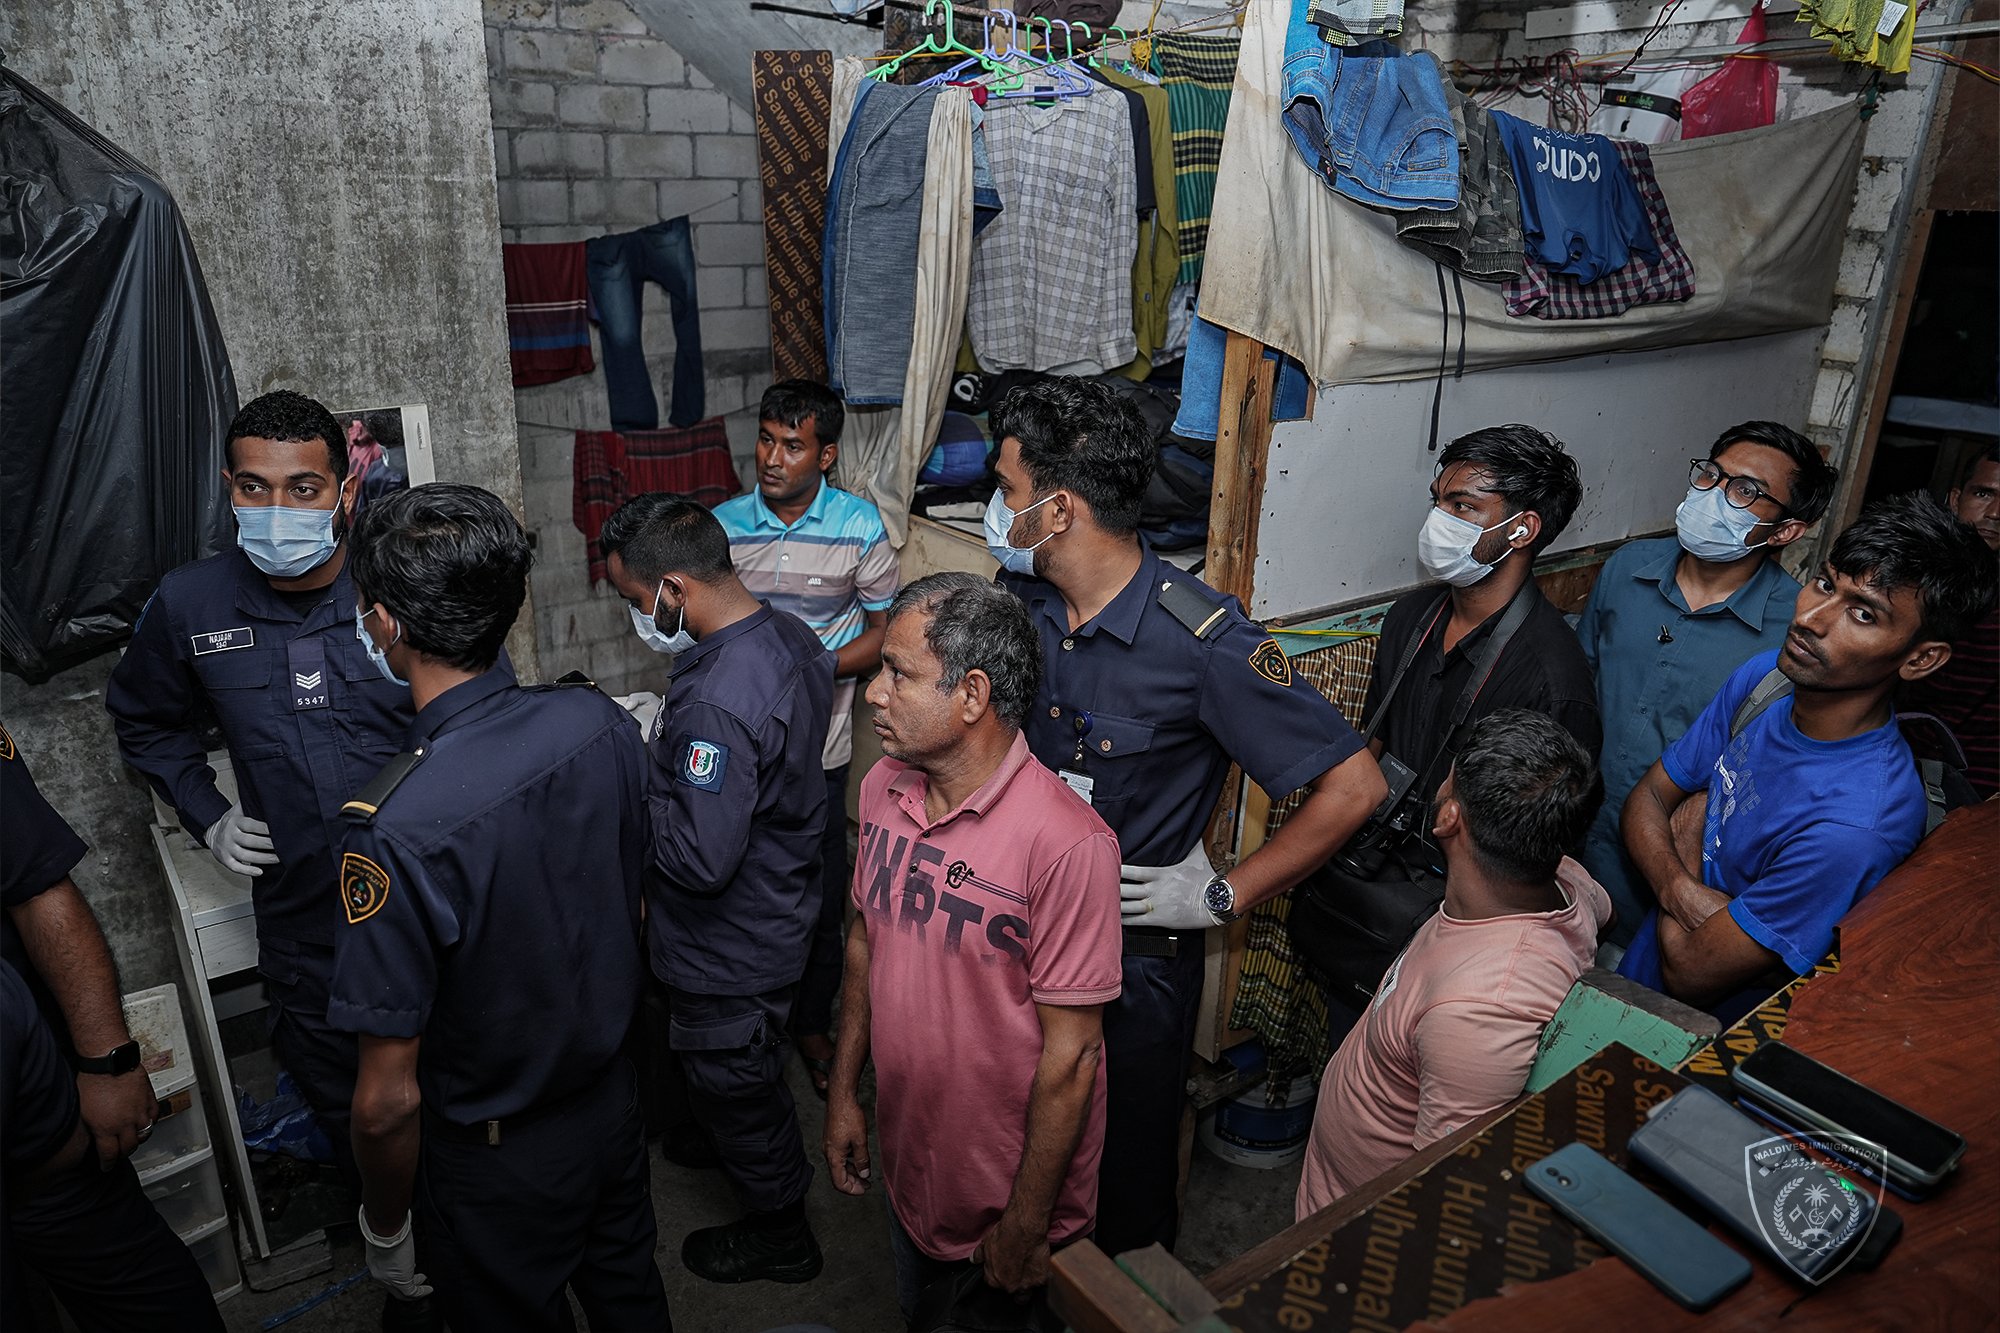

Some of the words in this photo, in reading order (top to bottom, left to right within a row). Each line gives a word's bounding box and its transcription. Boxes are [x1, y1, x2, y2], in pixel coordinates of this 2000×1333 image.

[763, 88, 812, 162] Sawmills
[781, 76, 828, 150] Sawmills
[780, 310, 825, 376] Sawmills
[297, 695, 325, 706] 5347
[865, 865, 1030, 968] ARTS
